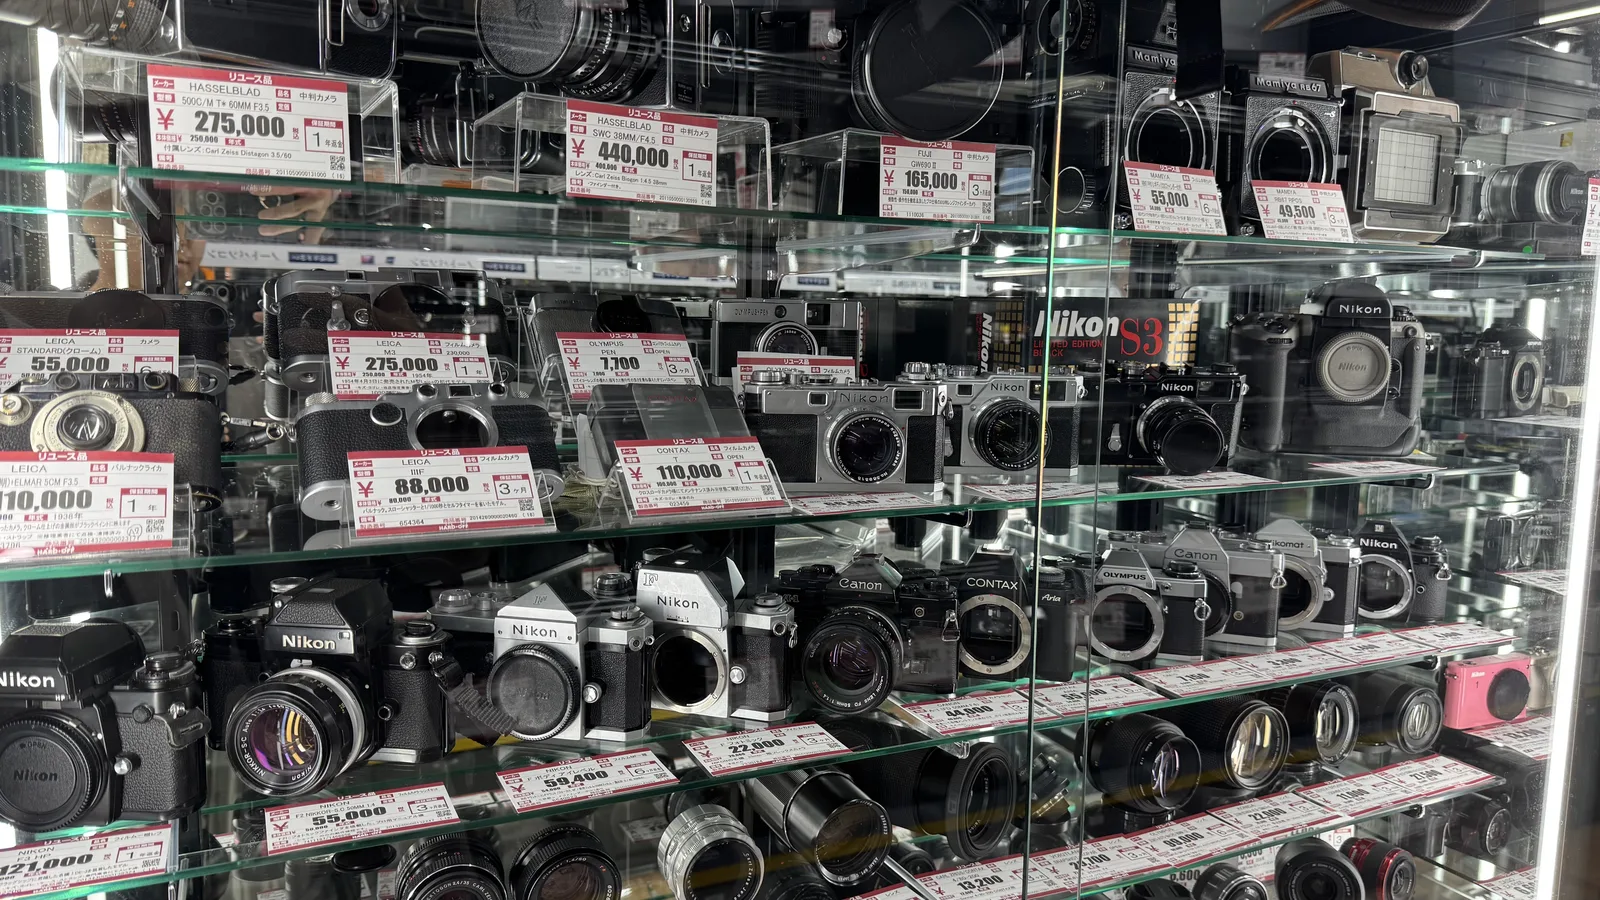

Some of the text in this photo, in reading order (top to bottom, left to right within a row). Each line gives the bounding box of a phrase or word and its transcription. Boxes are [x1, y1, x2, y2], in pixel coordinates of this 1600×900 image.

[1134, 51, 1177, 67] Mamiya
[229, 73, 272, 85] リユース品
[1256, 77, 1322, 92] Mamiya RB67
[190, 82, 337, 103] HASSELBLAD 中判カメラ
[182, 97, 214, 107] 500C/M
[229, 101, 251, 110] 60MM
[254, 103, 269, 111] F3.5
[628, 109, 660, 120] リユース品
[195, 111, 284, 138] 275,000
[598, 117, 709, 137] HASSELBLAD 中判カメラ
[190, 135, 218, 143] 250,000
[314, 132, 320, 147] 1
[593, 129, 655, 144] SWC 38MM/F4.5
[599, 142, 668, 168] 440,000
[596, 162, 617, 171] 400,000
[689, 164, 694, 176] 1
[905, 170, 957, 190] 165,000
[972, 184, 979, 196] 3
[1151, 190, 1189, 207] 55,000
[1203, 204, 1210, 213] 6
[1280, 205, 1315, 218] 49,500
[1330, 215, 1336, 223] 3
[1339, 304, 1382, 314] Nikon
[1034, 310, 1163, 356] Nikon S3
[981, 312, 993, 373] Nikon
[1033, 340, 1103, 348] LIITED EDITION
[31, 357, 110, 372] 55,000
[365, 357, 438, 371] 275,000
[600, 357, 640, 371] 7,700
[669, 364, 677, 373] 3
[1338, 363, 1367, 372] Nikon
[990, 383, 1025, 392] Nikon
[1161, 383, 1194, 392] Nikon
[839, 393, 889, 403] Nikon
[38, 453, 87, 461] リユース品
[657, 464, 722, 481] 110,000
[744, 471, 752, 481] 1
[395, 476, 469, 495] 88,000
[499, 483, 511, 495] 3
[127, 499, 135, 512] 1
[1359, 538, 1398, 549] Nikon
[1174, 549, 1218, 561] Canon
[642, 573, 659, 586] F
[1103, 571, 1147, 581] OLYMPUS
[839, 578, 882, 591] Canon
[967, 577, 1018, 590] CONTAX
[657, 595, 699, 609] Nikon
[1042, 594, 1061, 602] Aria
[512, 624, 557, 638] Nikon
[282, 635, 335, 650] Nikon
[0, 672, 55, 688] Nikon
[945, 706, 993, 717] 44,000
[728, 739, 785, 754] 22,000
[13, 770, 57, 781] Nikon
[545, 765, 572, 773] NIKON
[634, 767, 645, 775] 6
[544, 770, 608, 788] 59,400
[320, 801, 350, 809] NIKON
[313, 806, 387, 826] 55,000
[1163, 832, 1205, 847] 99,000
[18, 846, 55, 855] NIKON
[0, 854, 93, 876] 121,000
[957, 875, 1004, 890] 13,200
